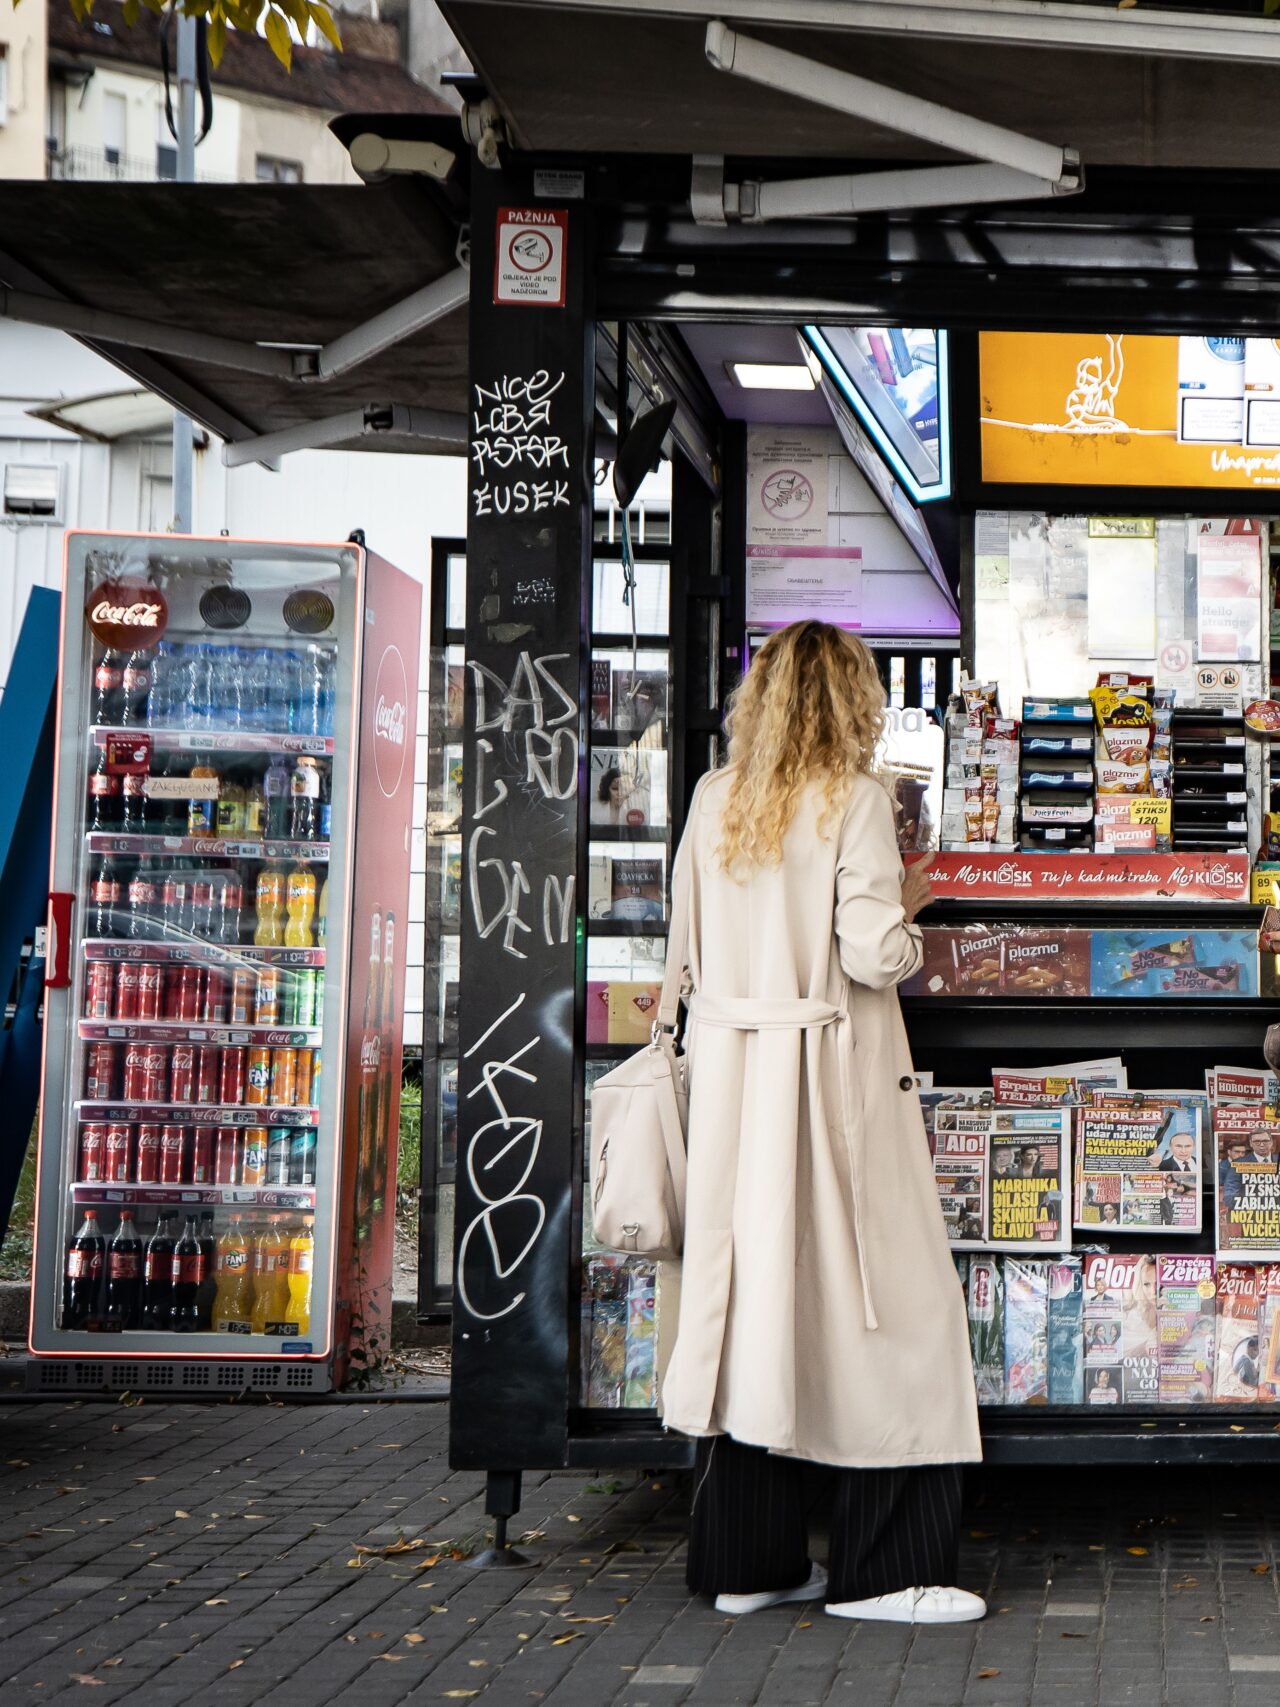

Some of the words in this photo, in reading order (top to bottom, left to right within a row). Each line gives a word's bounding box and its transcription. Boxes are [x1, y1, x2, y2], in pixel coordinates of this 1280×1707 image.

[508, 209, 556, 224] PAŽNJA
[1107, 737, 1142, 748] plazma
[1138, 816, 1158, 825] 120
[1104, 828, 1152, 843] plazma
[954, 865, 981, 884] Moj
[1041, 871, 1058, 882] Tu
[1058, 871, 1074, 887] je
[1078, 869, 1107, 883] kad
[1108, 871, 1127, 883] mi
[1127, 869, 1161, 882] treba
[1257, 878, 1270, 887] 89
[1008, 941, 1059, 962] plazma
[1138, 951, 1156, 962] No
[1132, 956, 1168, 972] Sugar
[1182, 969, 1200, 980] No
[1173, 976, 1210, 992] Sugar
[1000, 1079, 1042, 1092] Srpski
[1218, 1082, 1264, 1095] НОВОСТИ
[1217, 1109, 1260, 1119] Srpski
[1086, 1121, 1114, 1131] Putin
[1117, 1124, 1156, 1133] sprema
[1086, 1130, 1110, 1139] udar
[1129, 1131, 1156, 1140] Kijev
[946, 1135, 985, 1153] Alo!
[1086, 1138, 1158, 1148] SVEMIRSKOM
[1086, 1147, 1147, 1156] RAKETOM?!
[993, 1178, 1058, 1193] MARINIKA
[1245, 1184, 1257, 1197] IZ
[1257, 1184, 1280, 1197] SNS
[993, 1207, 1049, 1223] SKINULA
[1255, 1211, 1264, 1224] U
[993, 1223, 1034, 1239] GLAVU
[1175, 1258, 1211, 1267] srećna
[1123, 1357, 1149, 1368] OVO
[1132, 1367, 1156, 1379] NAJ
